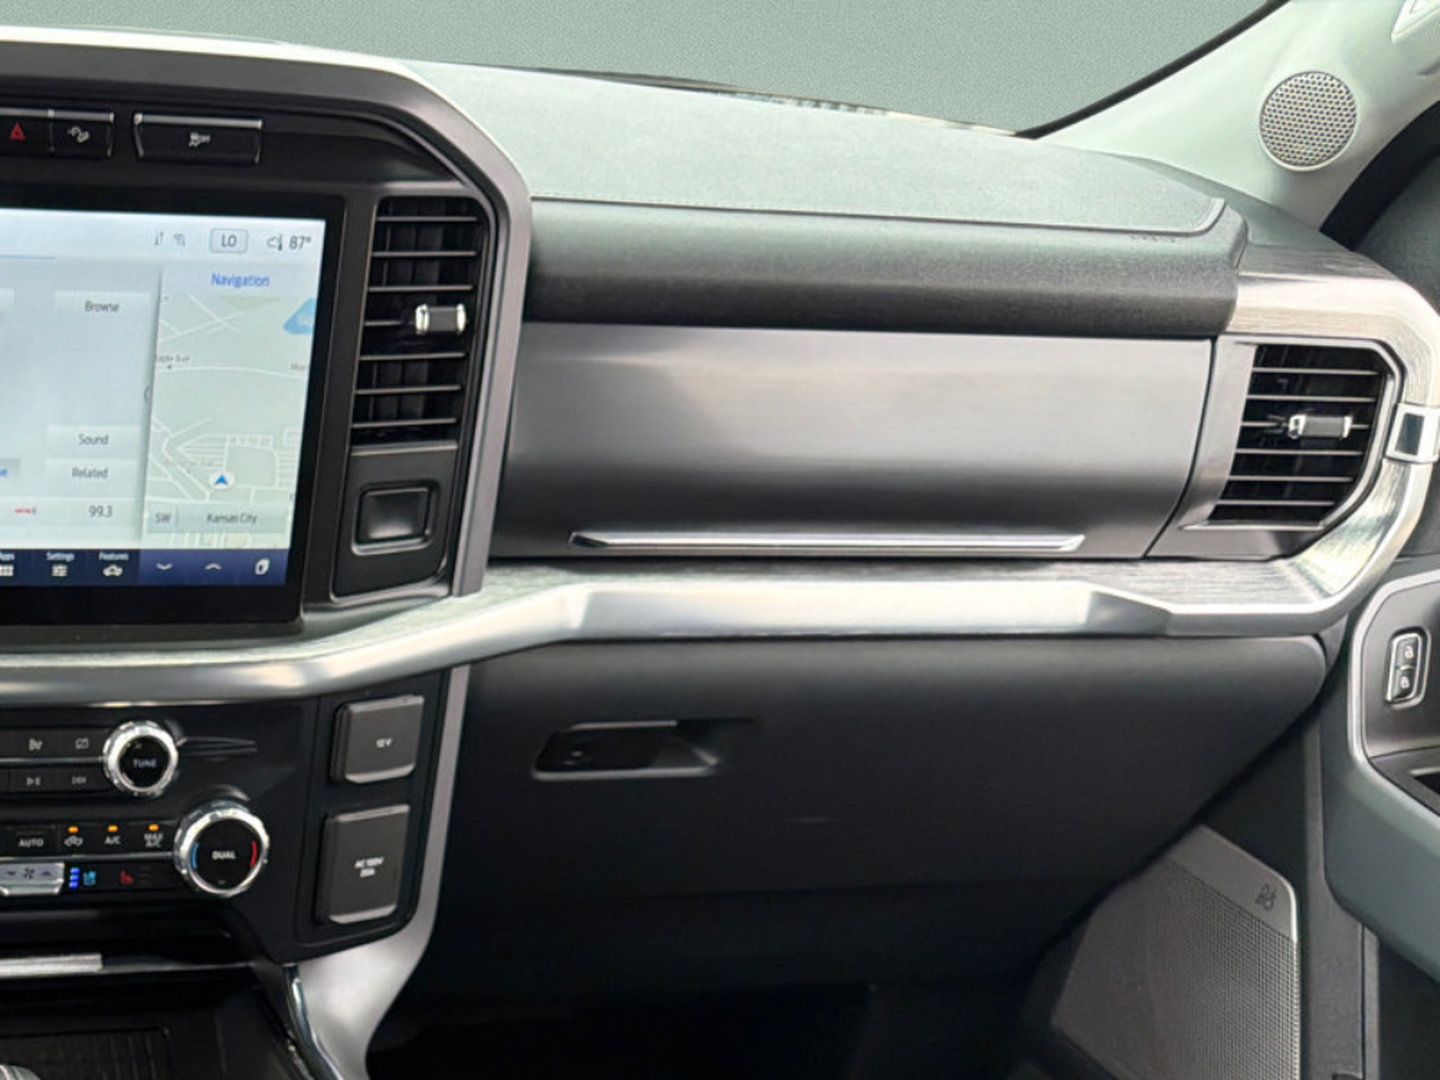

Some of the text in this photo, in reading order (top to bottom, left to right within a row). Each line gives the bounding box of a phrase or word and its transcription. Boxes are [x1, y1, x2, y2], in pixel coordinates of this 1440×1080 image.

[221, 234, 237, 247] LO
[289, 236, 312, 250] 87°
[211, 273, 271, 289] Navigation
[84, 300, 120, 313] Browse
[78, 433, 109, 447] Sound
[71, 468, 109, 480] Related
[89, 505, 112, 518] 99.3
[156, 514, 170, 524] SW
[207, 513, 258, 526] Kansas City
[46, 552, 75, 563] Settings
[133, 759, 157, 769] TUNE
[18, 838, 44, 848] AUTO
[105, 836, 120, 845] A/C
[212, 850, 236, 860] DUAL
